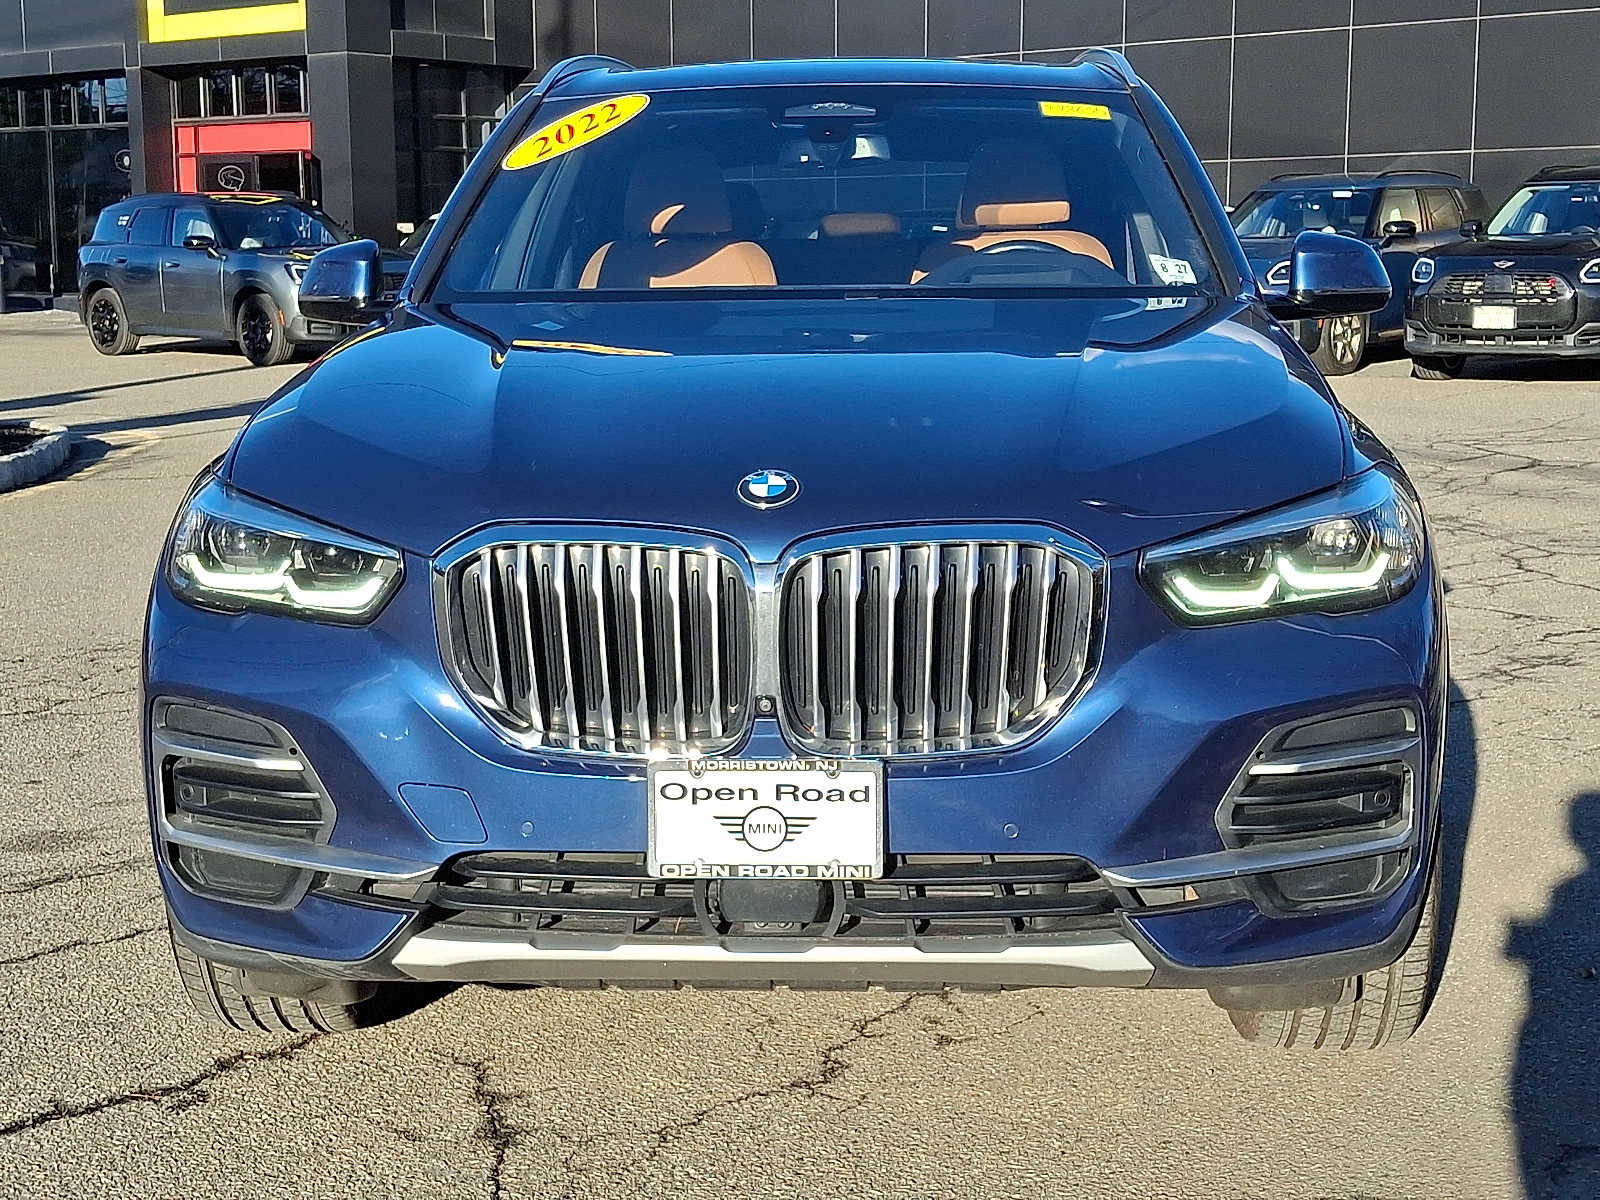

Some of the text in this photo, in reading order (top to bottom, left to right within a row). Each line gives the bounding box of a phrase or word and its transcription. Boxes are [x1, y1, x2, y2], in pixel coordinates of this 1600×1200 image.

[533, 103, 622, 158] 2022
[1160, 263, 1188, 274] 8 27
[691, 760, 839, 771] MORRISTOWN, NJ
[660, 782, 870, 805] Open Road
[748, 824, 783, 834] MINI
[661, 864, 873, 878] OPEN ROAD MINI
